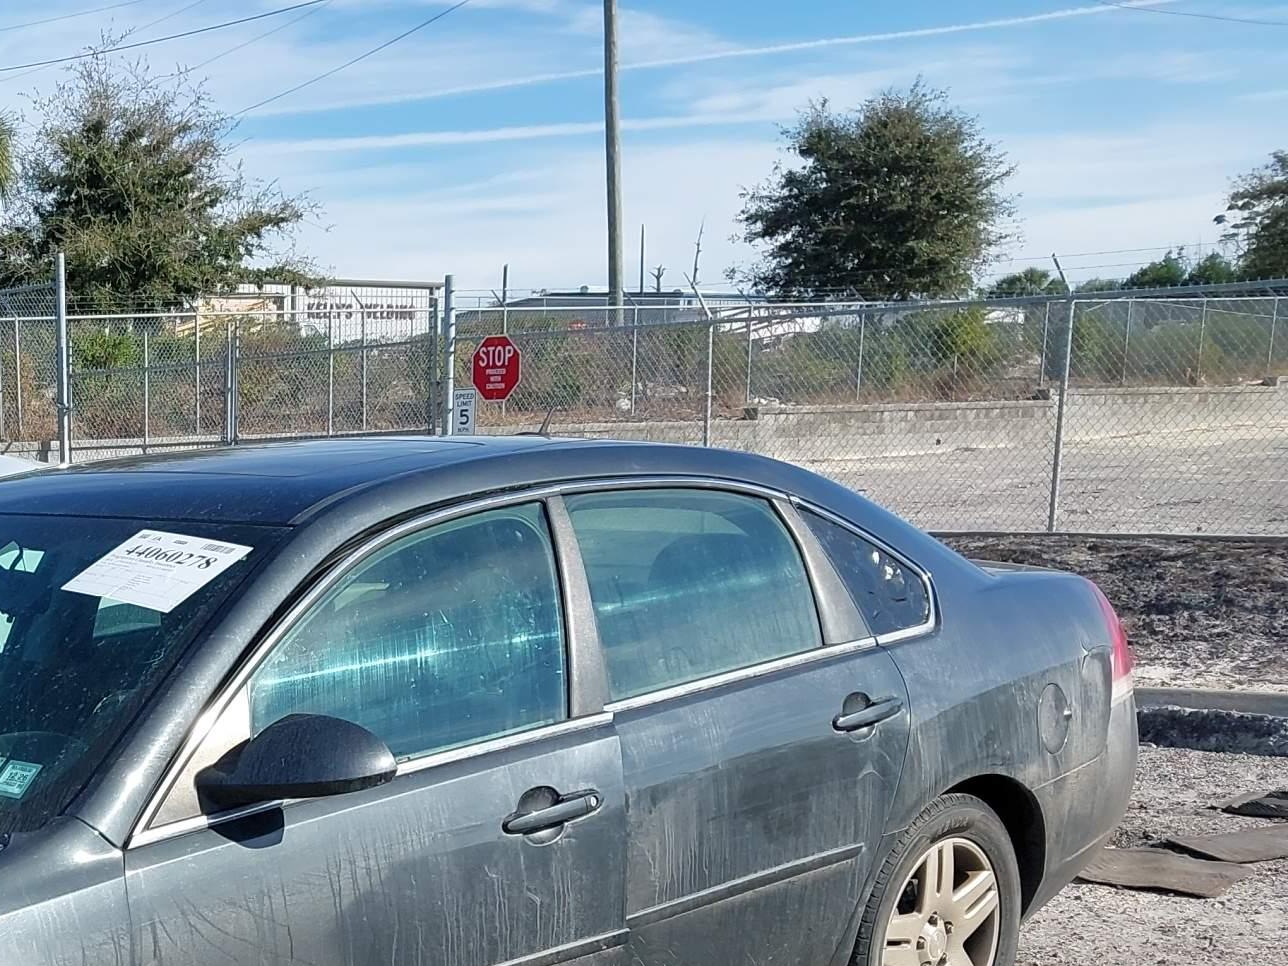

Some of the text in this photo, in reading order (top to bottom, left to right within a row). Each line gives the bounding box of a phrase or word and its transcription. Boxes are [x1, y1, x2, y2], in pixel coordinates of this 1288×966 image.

[360, 303, 416, 320] WELDING
[478, 345, 514, 367] STOP
[455, 392, 474, 400] SPEED
[459, 408, 469, 425] 5
[125, 543, 218, 570] 44060278
